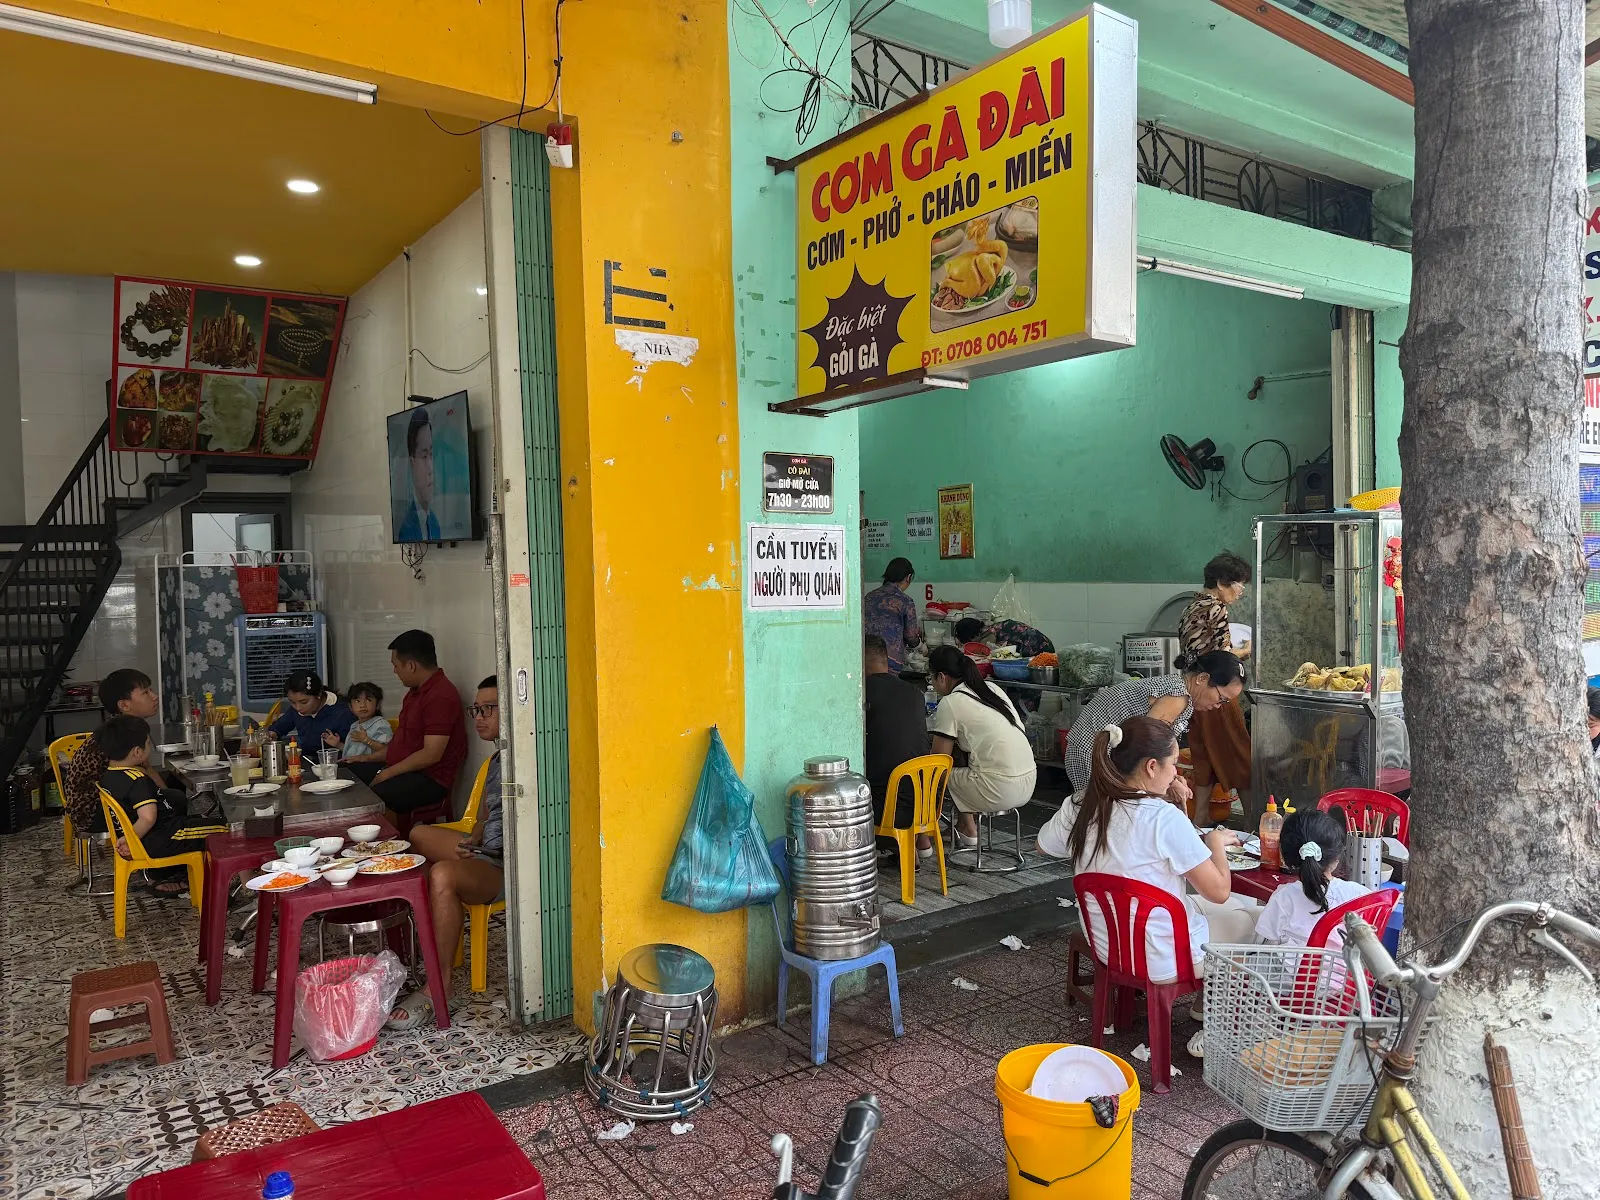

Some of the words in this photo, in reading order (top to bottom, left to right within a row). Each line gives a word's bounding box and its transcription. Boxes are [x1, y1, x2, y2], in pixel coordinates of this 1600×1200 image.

[811, 142, 893, 222] CƠM
[902, 105, 968, 181] GÀ
[977, 56, 1065, 151] ĐÀI
[807, 229, 845, 270] CƠM
[863, 195, 901, 249] PHỞ
[922, 171, 980, 225] CHÁO
[1005, 128, 1072, 193] MIẾN
[826, 316, 854, 342] Đặc
[857, 304, 887, 333] biệt
[644, 341, 672, 356] NHÀ
[829, 342, 854, 378] GỎI
[858, 337, 879, 371] GÀ
[921, 348, 942, 368] ĐT:
[946, 337, 982, 361] 0708
[986, 328, 1018, 352] 004
[1022, 319, 1047, 342] 751
[778, 477, 791, 489] GIỜ
[792, 477, 804, 490] MỞ
[805, 477, 819, 491] CỬA
[787, 466, 797, 475] CÔ
[768, 492, 792, 507] 7h30
[801, 494, 830, 509] 23h00
[756, 532, 786, 560] CẦN
[791, 532, 837, 560] TUYỂN
[754, 565, 786, 597] NGƯỜI
[790, 571, 810, 601] PHỤ
[814, 565, 841, 600] QUÁN
[925, 584, 933, 600] 6
